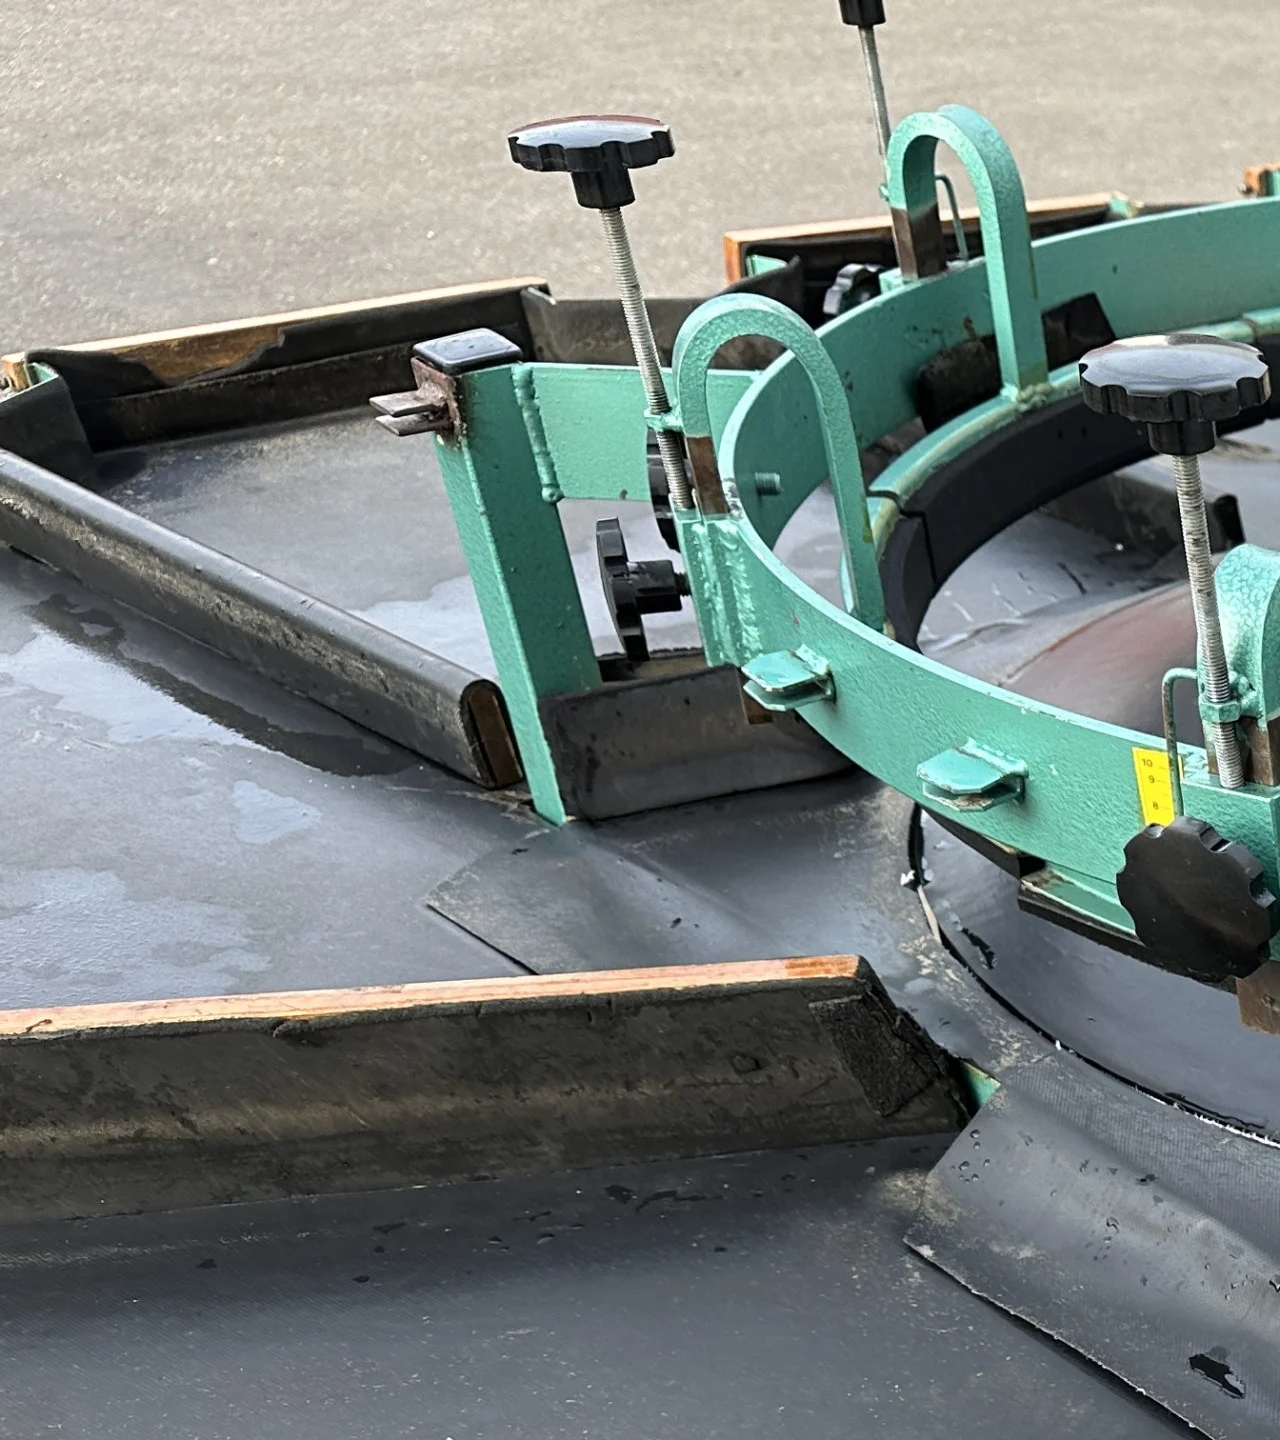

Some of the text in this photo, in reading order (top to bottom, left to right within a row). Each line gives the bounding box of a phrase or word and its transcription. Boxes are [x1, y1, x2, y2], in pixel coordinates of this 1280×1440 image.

[1142, 758, 1153, 767] 10
[1148, 774, 1155, 784] 9
[1152, 801, 1160, 811] 8
